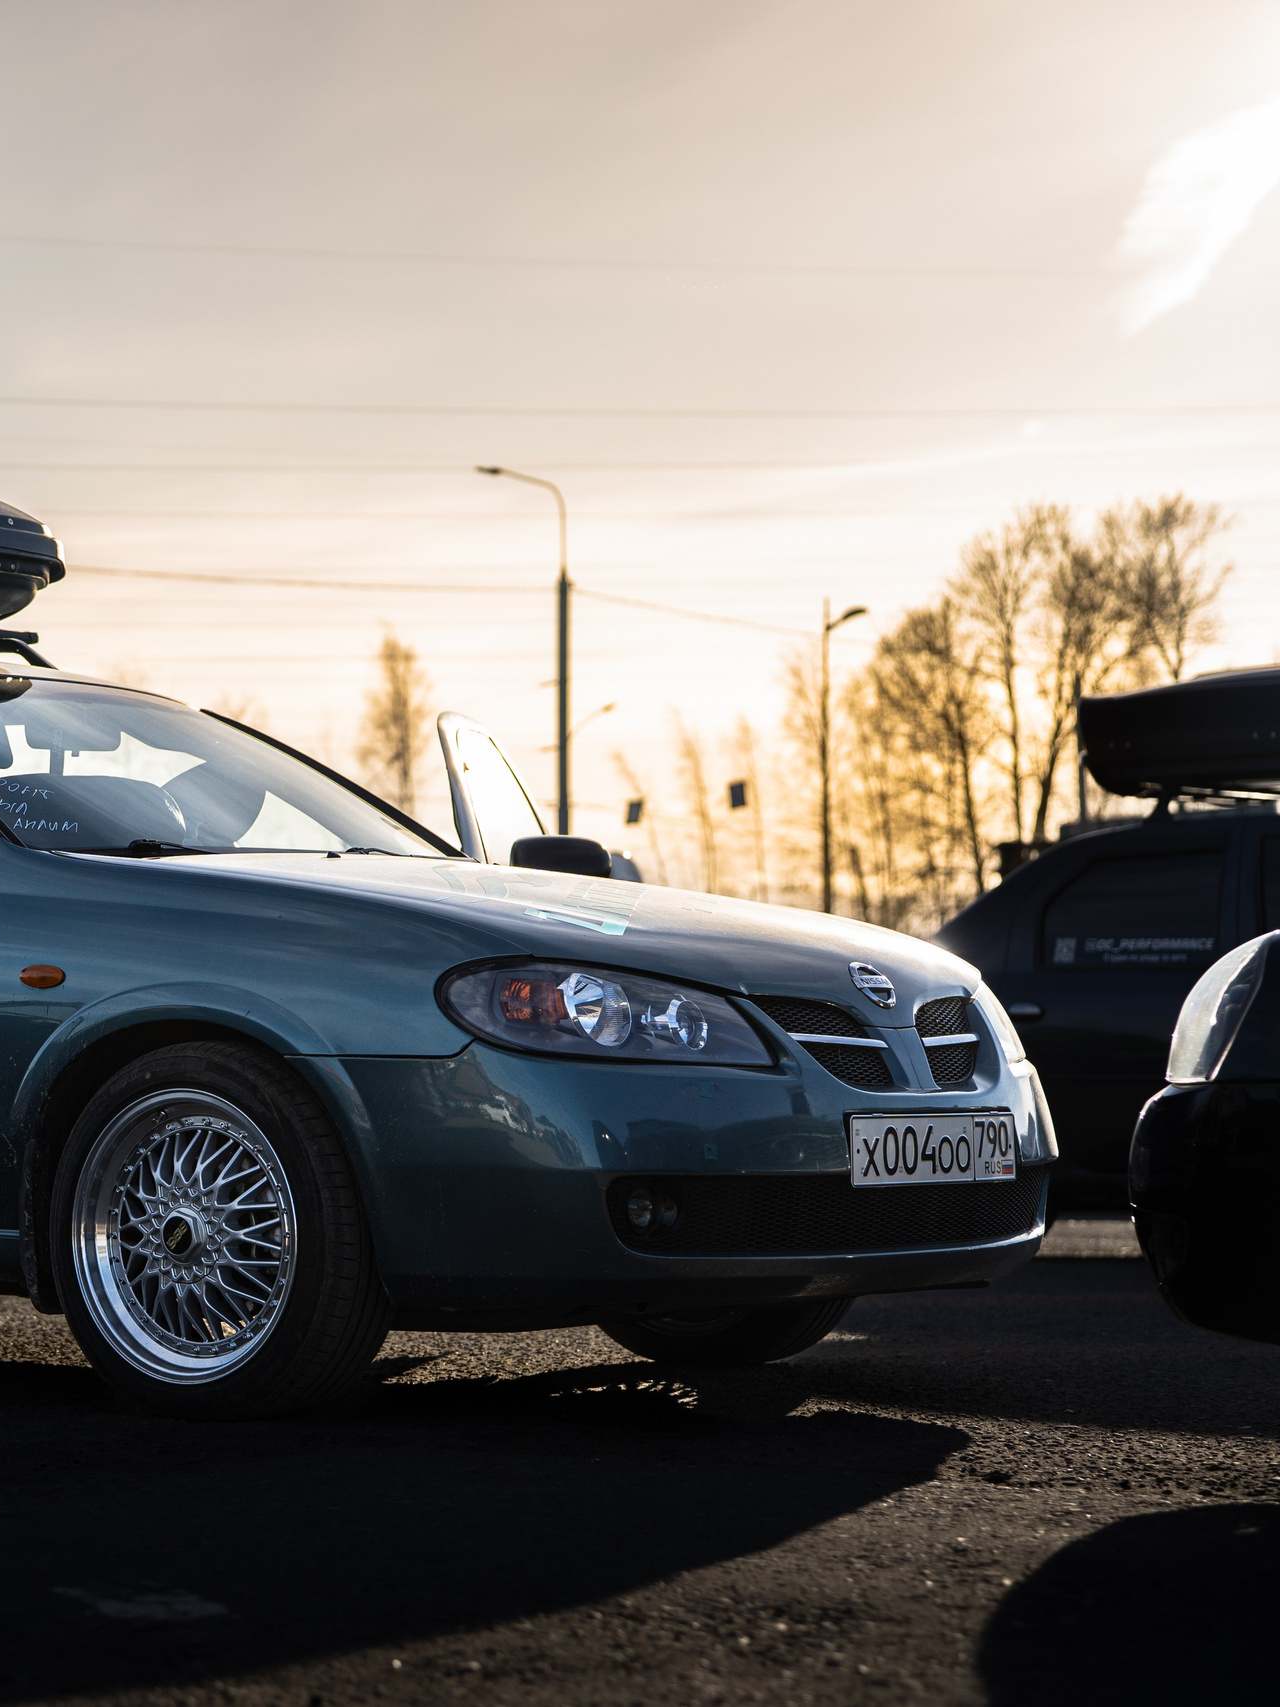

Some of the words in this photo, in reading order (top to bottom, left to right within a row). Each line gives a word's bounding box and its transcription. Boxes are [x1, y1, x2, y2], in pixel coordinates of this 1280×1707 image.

[975, 1119, 1009, 1158] 790
[984, 1160, 1002, 1174] RUS
[166, 1219, 189, 1252] BBS
